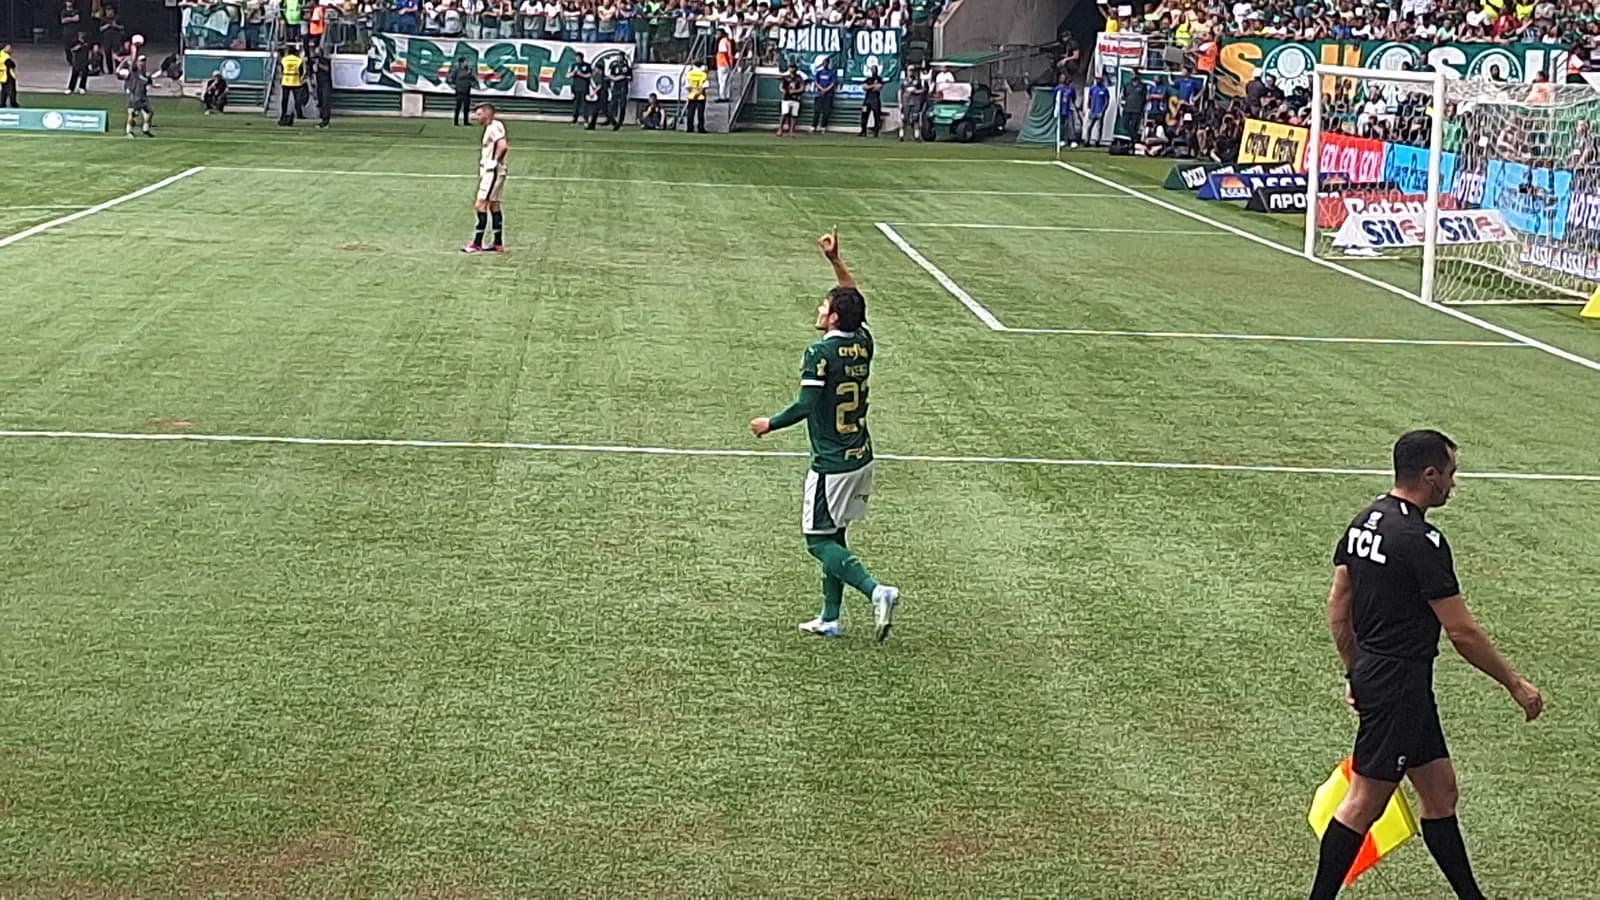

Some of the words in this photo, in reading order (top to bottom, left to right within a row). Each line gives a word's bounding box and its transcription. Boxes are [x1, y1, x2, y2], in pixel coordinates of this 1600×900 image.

[779, 24, 841, 52] FAMÍLIA
[856, 30, 898, 55] 08A
[1347, 527, 1387, 564] TCL
